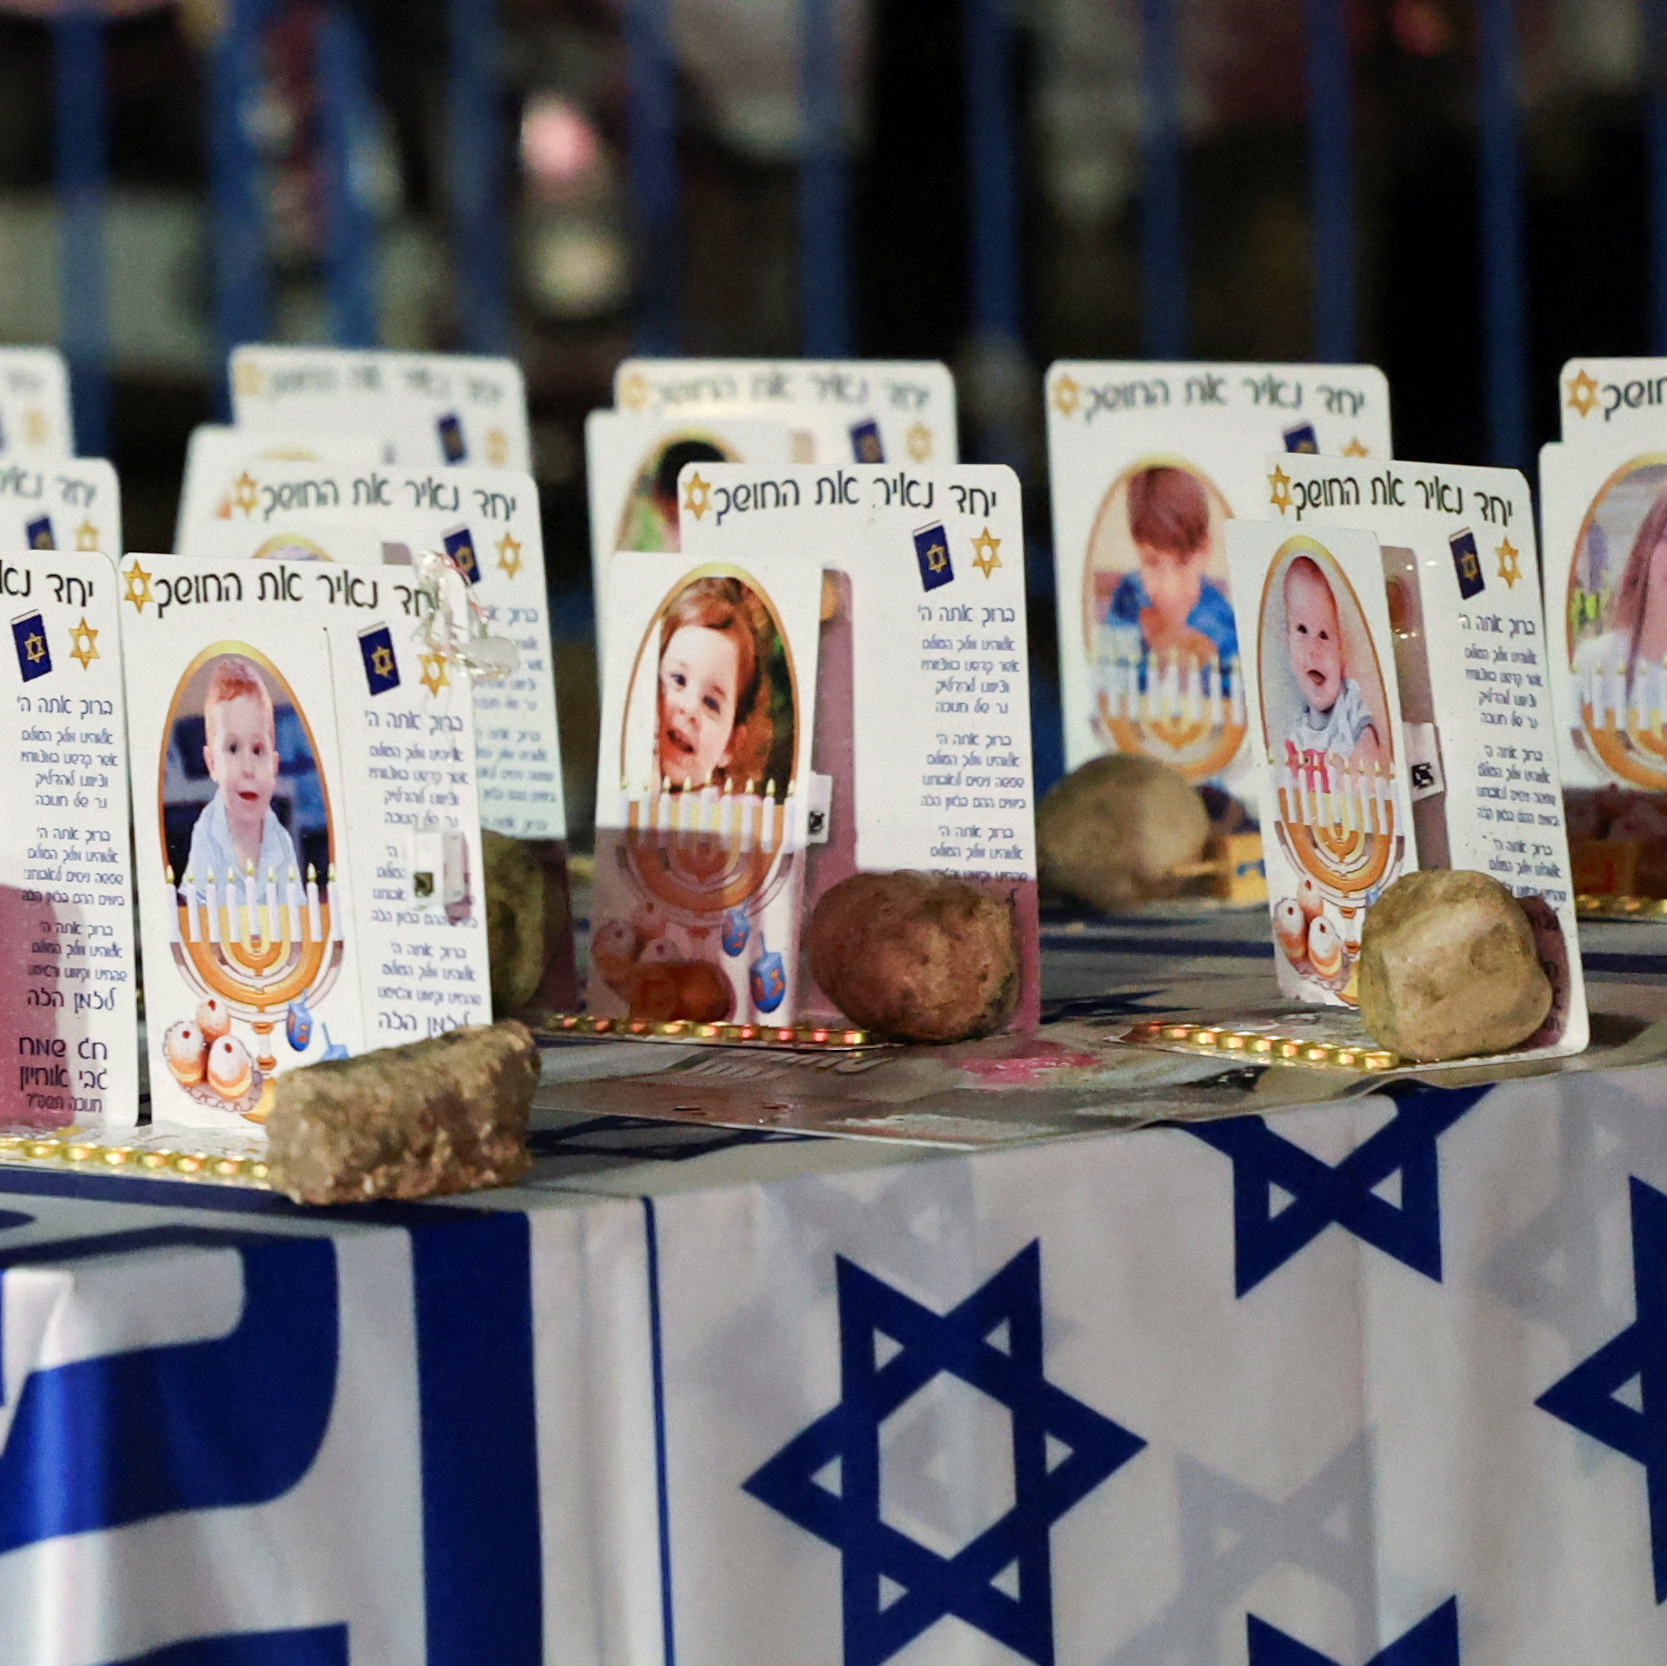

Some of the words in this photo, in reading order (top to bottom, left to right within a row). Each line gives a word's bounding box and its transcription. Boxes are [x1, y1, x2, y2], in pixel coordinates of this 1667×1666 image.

[263, 479, 340, 522] החושך
[352, 474, 391, 506] את
[406, 483, 460, 513] נאיר
[715, 479, 800, 526] החושך
[816, 473, 858, 505] את
[874, 477, 934, 510] נאיר
[950, 485, 997, 518] יחד
[1294, 476, 1360, 521] החושך
[1371, 477, 1404, 507] את
[1415, 481, 1463, 515] נאיר
[473, 489, 517, 522] יחד
[1474, 491, 1512, 527] יחד
[47, 573, 93, 607] יחד
[156, 572, 243, 619] החושך
[258, 567, 301, 602] את
[317, 571, 378, 610] נאיר
[939, 604, 973, 622] אתה
[982, 607, 1015, 628] ברוך
[38, 696, 71, 714] אתה
[80, 699, 113, 720] ברוך
[386, 711, 421, 730] אתה
[429, 715, 464, 736] ברוך
[27, 987, 64, 1007] הזה
[74, 987, 116, 1014] לזמן
[19, 1036, 66, 1058] שמח
[77, 1037, 108, 1061] חג
[19, 1064, 68, 1092] אוחיון
[78, 1068, 108, 1091] גבי
